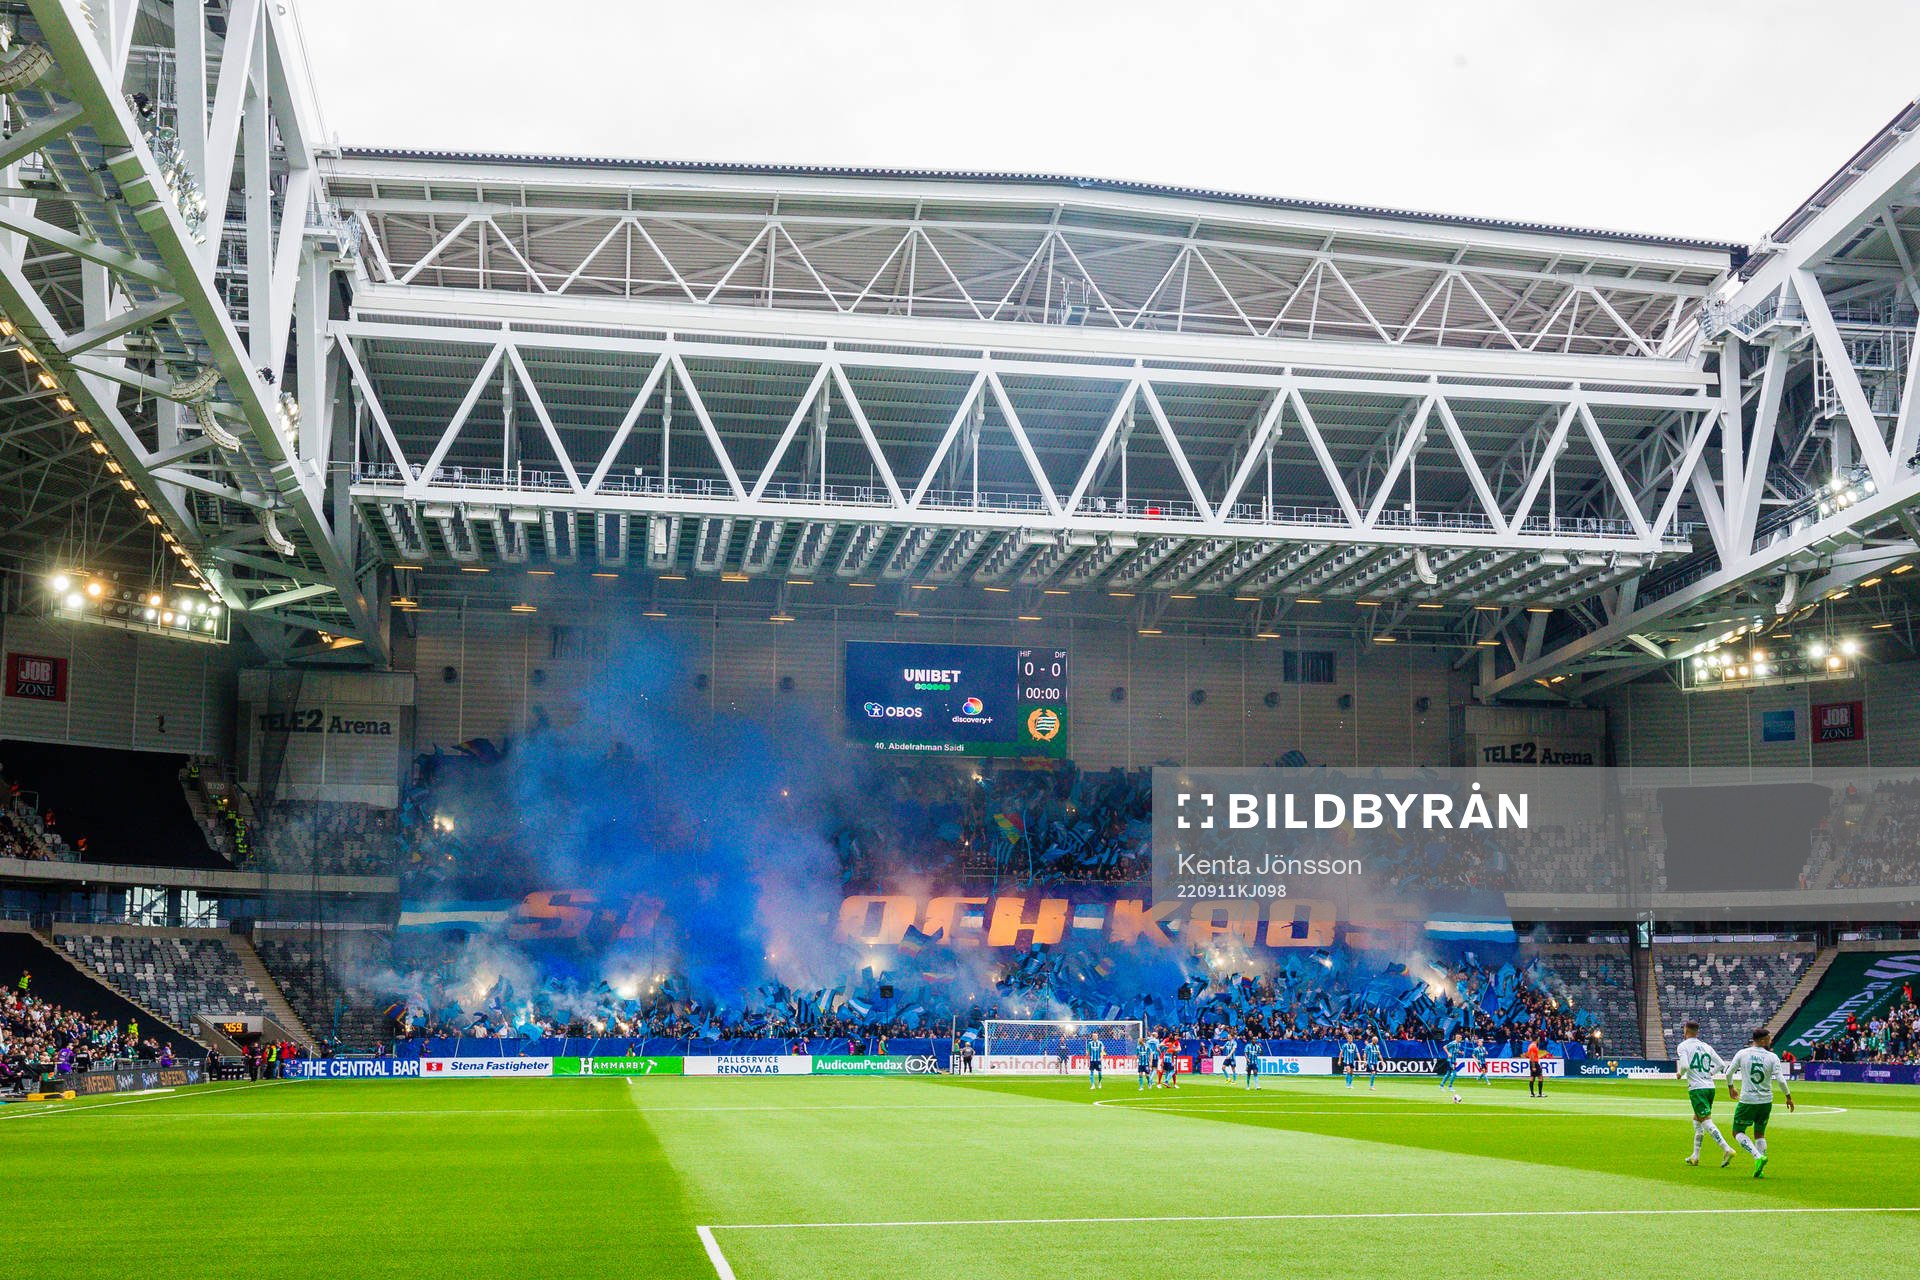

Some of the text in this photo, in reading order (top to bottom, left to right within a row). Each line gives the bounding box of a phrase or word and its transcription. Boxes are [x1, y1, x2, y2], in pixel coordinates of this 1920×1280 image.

[1054, 651, 1067, 659] DIF
[20, 660, 51, 682] JOB
[904, 668, 961, 683] UNIBET
[1024, 662, 1034, 676] 0
[1051, 663, 1061, 677] 0
[17, 683, 56, 697] ZONE
[1026, 687, 1060, 700] 00:00
[885, 706, 923, 718] OBOS
[1823, 707, 1848, 727] JOB
[259, 709, 391, 735] TELE2 Arena
[1822, 727, 1854, 740] ZONE
[888, 743, 943, 752] Abdelrahman
[1483, 742, 1594, 766] TELE2 Arena
[302, 1060, 420, 1076] THE CENTRAL BAR
[451, 1061, 549, 1072] Stena Fastigheter
[580, 1057, 645, 1075] HAMMARBY
[717, 1065, 779, 1074] RENOVA AB
[816, 1059, 903, 1071] AudicomPendax
[1468, 1061, 1557, 1073] INTERSPRT
[1580, 1064, 1610, 1075] Sefina
[1689, 1052, 1712, 1073] 40
[1750, 1062, 1765, 1085] 5
